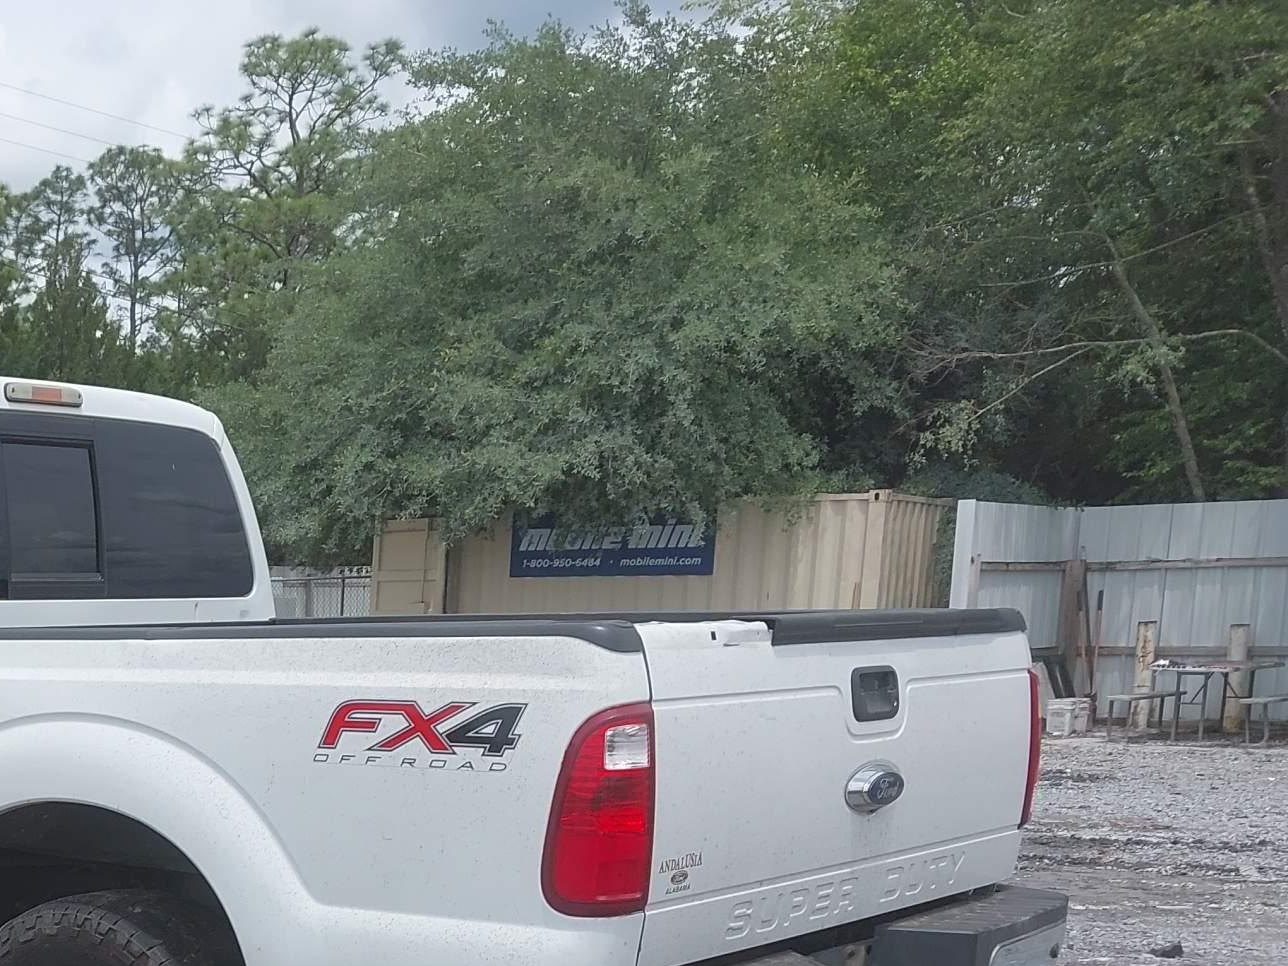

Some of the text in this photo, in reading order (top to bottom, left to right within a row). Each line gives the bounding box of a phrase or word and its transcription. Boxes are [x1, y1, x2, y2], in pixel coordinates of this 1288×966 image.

[620, 556, 702, 567] mobilemini.com
[317, 699, 528, 757] FX4
[313, 753, 508, 772] OFF ROAD
[725, 850, 966, 940] SUPER DUTY
